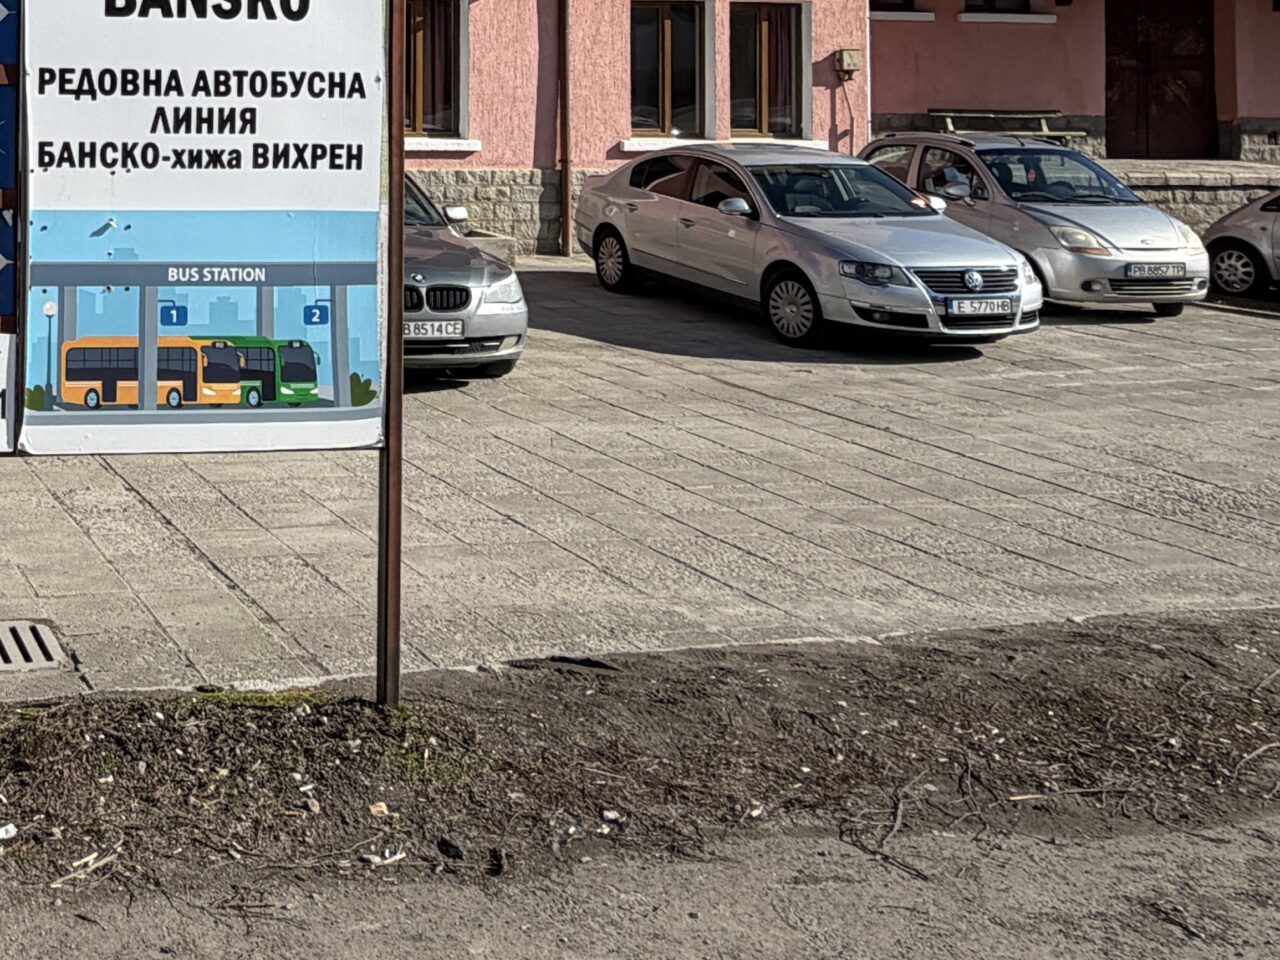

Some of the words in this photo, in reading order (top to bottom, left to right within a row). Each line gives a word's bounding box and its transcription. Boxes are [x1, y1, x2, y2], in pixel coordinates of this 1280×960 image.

[38, 67, 184, 100] РЕДОВНА
[191, 70, 366, 99] АВТОБУСНА
[150, 107, 257, 134] ЛИНИЯ
[38, 141, 242, 169] БАНСКО-хижа
[251, 143, 363, 171] ВИХРЕН
[168, 267, 199, 282] BUS
[203, 267, 266, 282] STATION
[957, 301, 965, 313] E
[970, 301, 995, 313] 5770
[169, 309, 177, 323] 1
[311, 309, 320, 323] 2
[413, 323, 443, 336] 8514
[445, 323, 461, 335] CE
